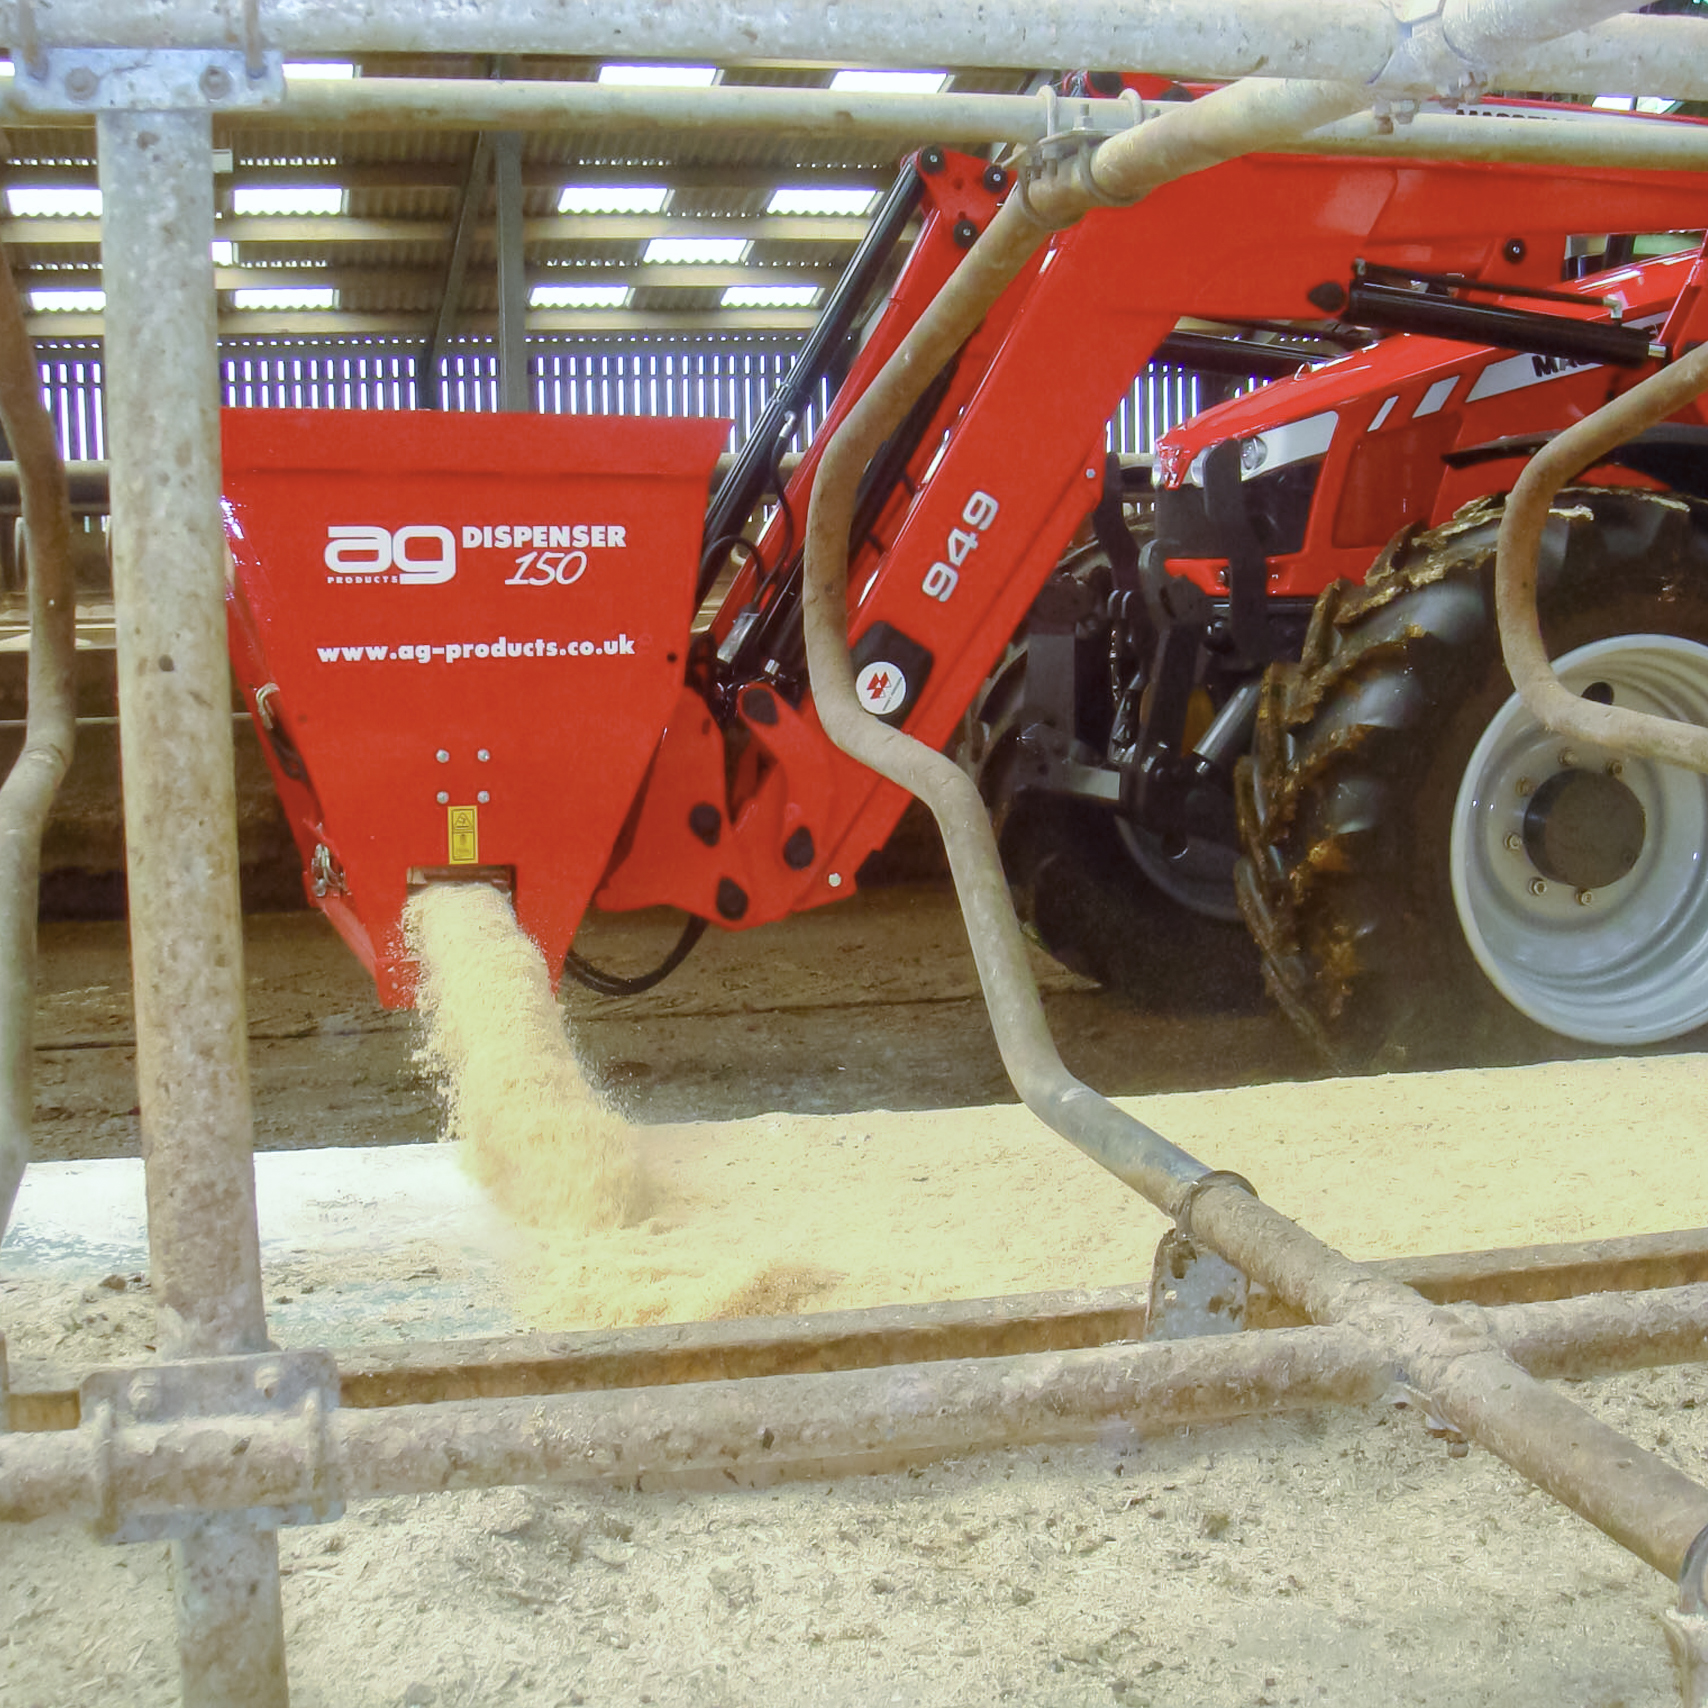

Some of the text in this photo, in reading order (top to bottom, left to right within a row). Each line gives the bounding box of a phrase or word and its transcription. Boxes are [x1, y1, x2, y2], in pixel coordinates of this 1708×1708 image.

[324, 525, 626, 585] ag DISPENSER
[922, 490, 998, 602] 949
[327, 576, 398, 584] PRODUCTS
[505, 551, 587, 585] 150
[317, 634, 635, 663] www.ag-products.co.uk
